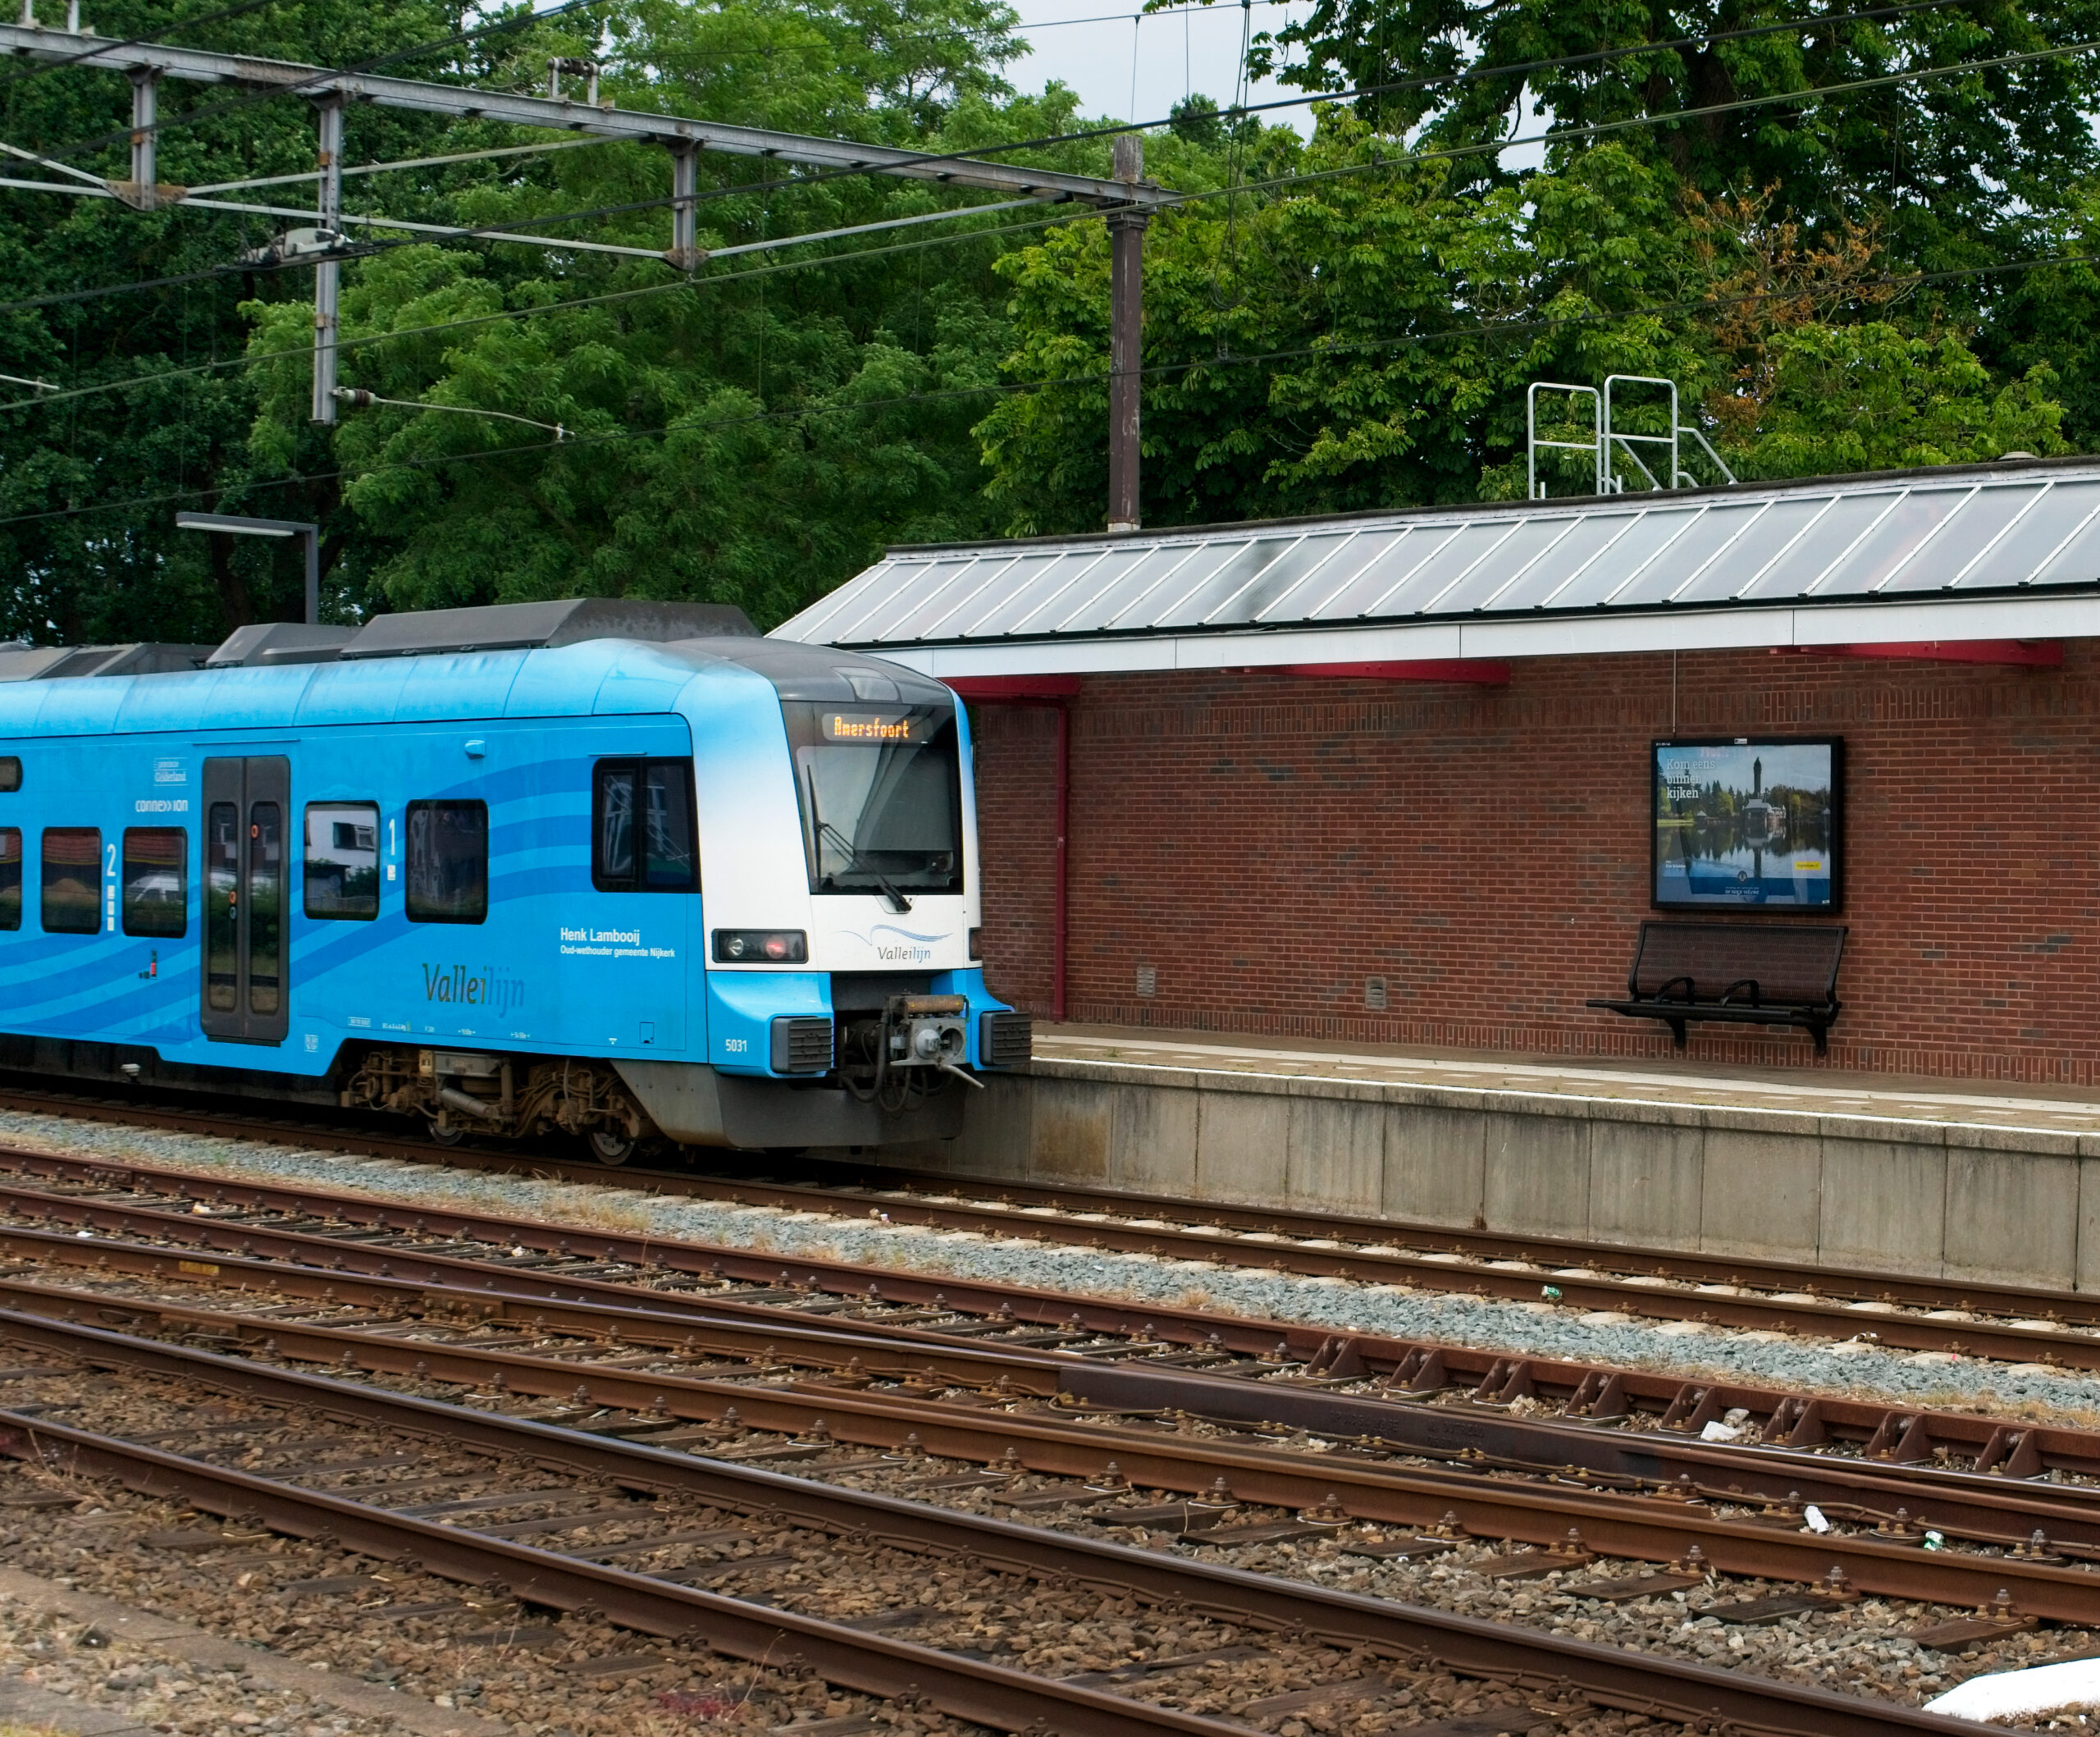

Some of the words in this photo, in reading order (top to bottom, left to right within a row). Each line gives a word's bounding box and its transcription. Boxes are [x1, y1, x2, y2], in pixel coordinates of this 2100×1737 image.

[834, 716, 909, 738] Amersfoort
[1666, 758, 1691, 770] Kom
[1692, 759, 1716, 770] eens
[1666, 774, 1702, 784] binnen
[1666, 787, 1700, 802] kijken
[389, 818, 395, 856] 1
[107, 843, 116, 877] 2
[560, 927, 587, 942] Henk
[590, 928, 641, 946] Lambooij
[560, 944, 614, 956] Oud-wethouder
[614, 947, 649, 958] gemeente
[650, 948, 676, 959] Nijkerk
[877, 946, 931, 963] Valleilijn
[422, 962, 525, 1019] Valleilijn
[725, 1038, 747, 1053] 5031
